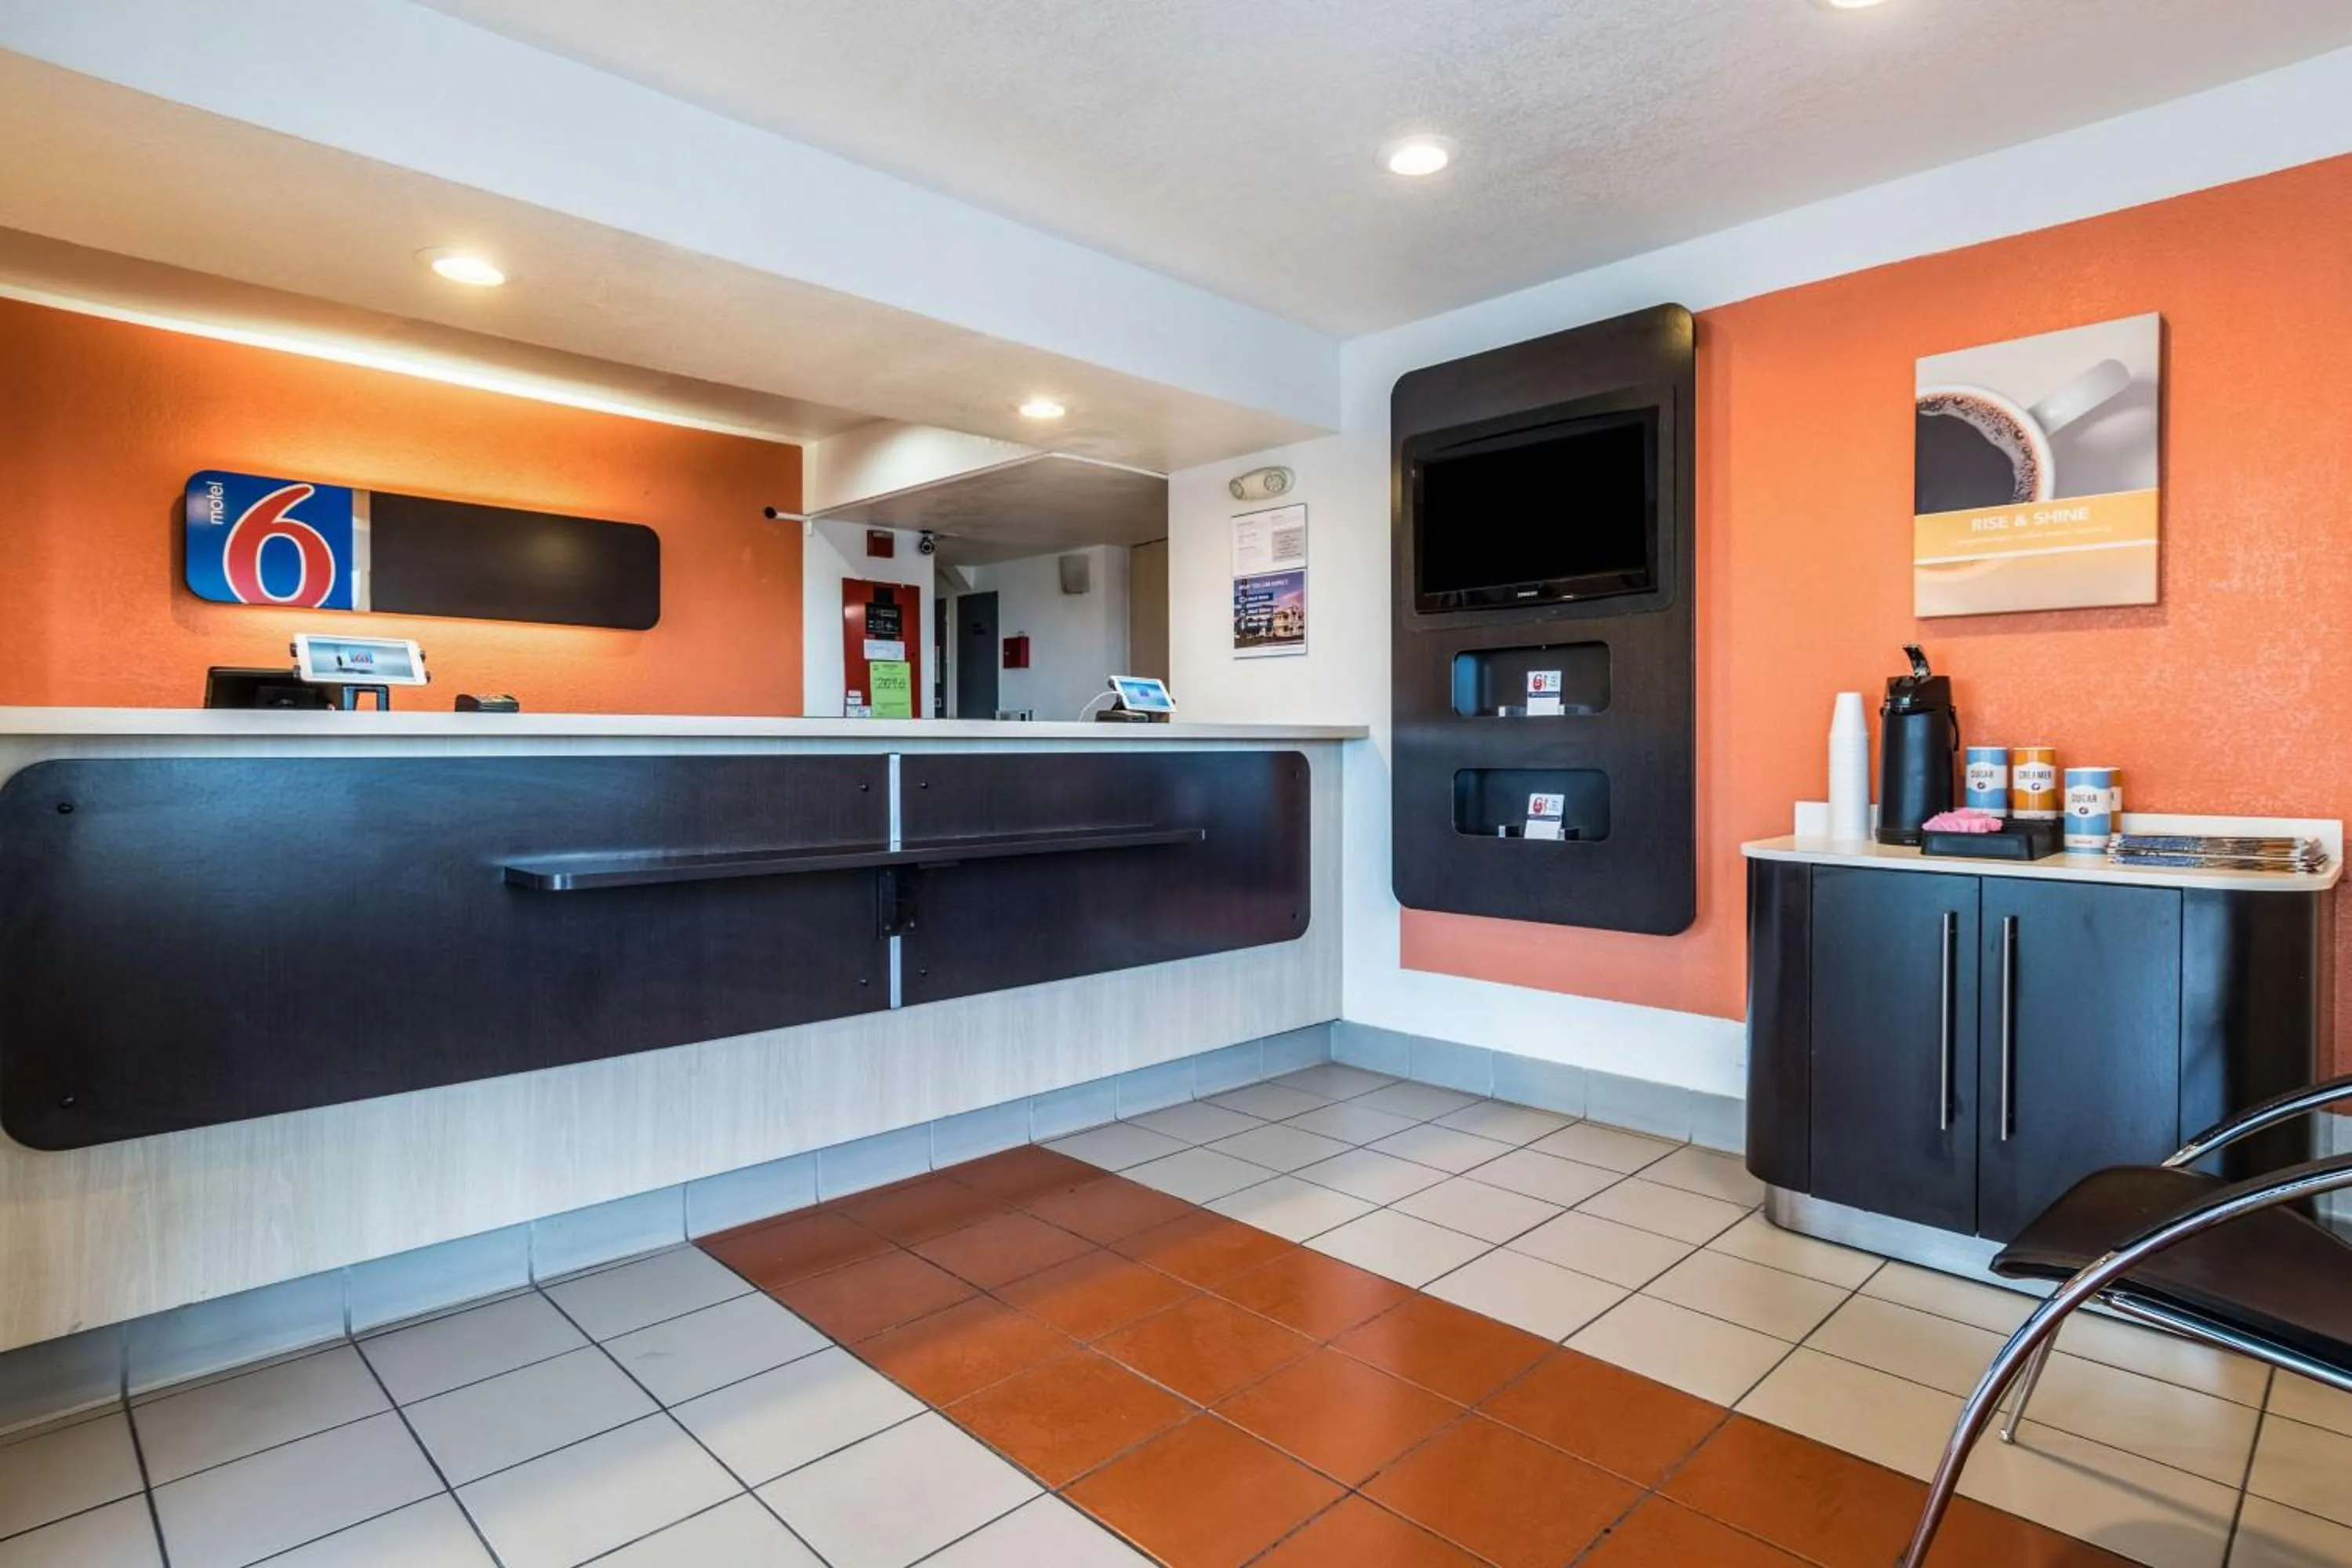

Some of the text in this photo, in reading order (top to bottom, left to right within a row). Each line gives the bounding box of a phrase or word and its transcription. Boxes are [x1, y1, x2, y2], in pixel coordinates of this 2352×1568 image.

[206, 481, 224, 524] motel
[1971, 516, 2009, 532] RISE
[2013, 514, 2028, 527] &
[2033, 507, 2090, 525] SHINE
[223, 483, 336, 608] 6
[1970, 770, 1994, 779] SUGAR
[2019, 770, 2052, 779] CREAMER
[2071, 793, 2098, 804] SUGAR
